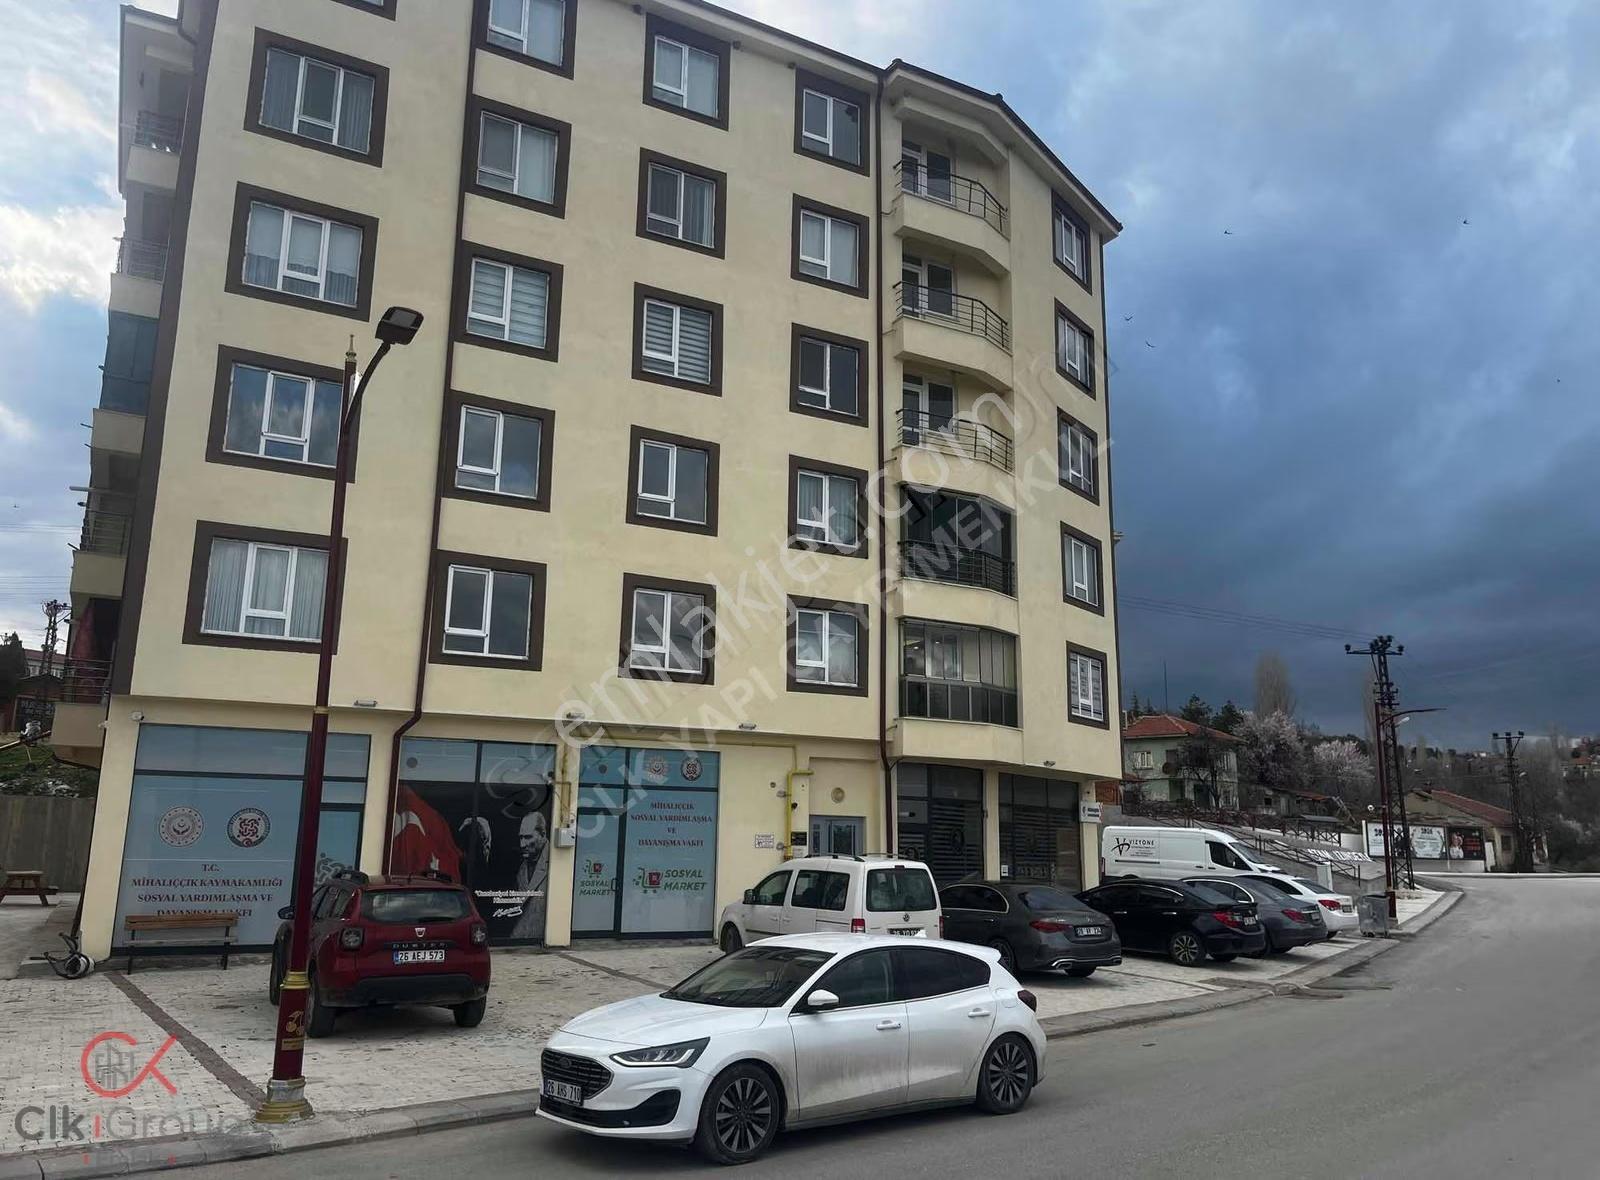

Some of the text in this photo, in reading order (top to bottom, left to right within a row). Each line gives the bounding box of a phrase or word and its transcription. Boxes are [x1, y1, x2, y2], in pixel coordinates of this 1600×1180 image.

[202, 864, 220, 872] T.C.
[664, 869, 703, 878] SOSYAL
[200, 877, 283, 887] KAYMAKAMLIĞI
[663, 882, 707, 891] MARKET
[137, 893, 273, 904] SOSYAL YARDIMLAŞMA VE
[400, 950, 444, 961] 26 AEJ 573
[547, 1079, 555, 1095] 26
